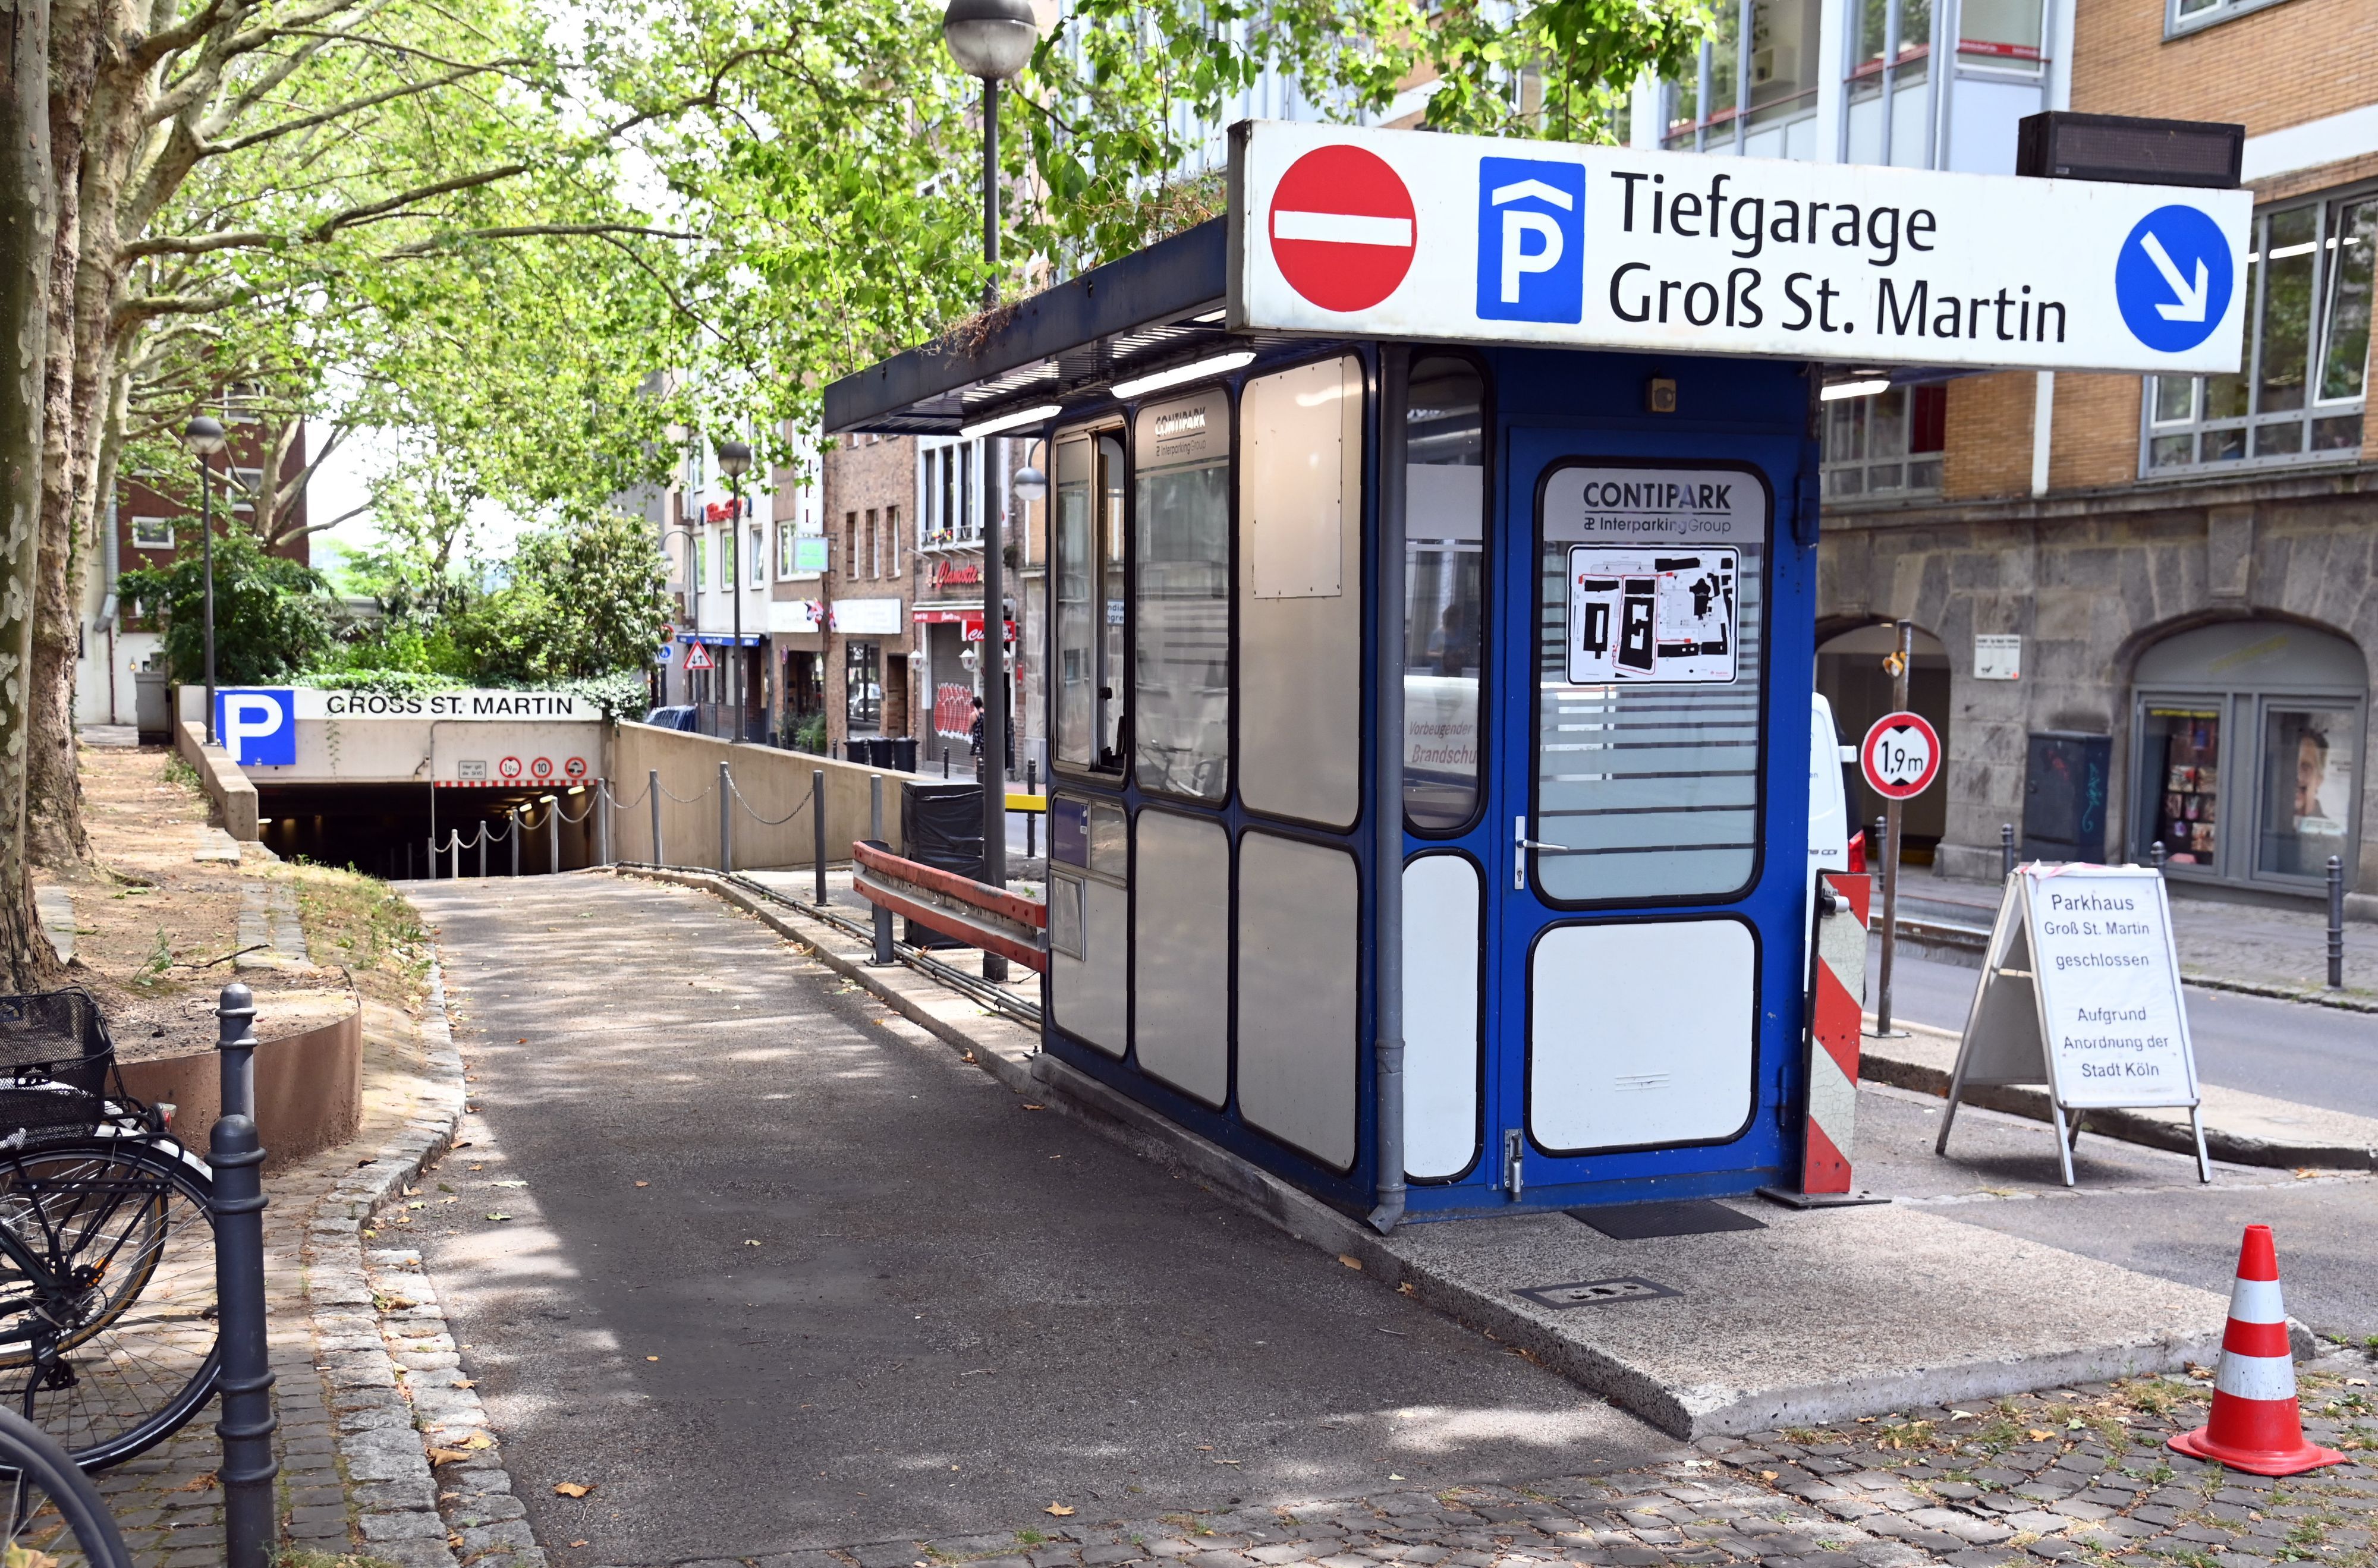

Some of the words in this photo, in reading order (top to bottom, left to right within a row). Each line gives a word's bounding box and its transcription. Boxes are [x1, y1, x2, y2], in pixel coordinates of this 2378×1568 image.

[1611, 170, 1936, 267] Tiefgarage
[1501, 209, 1564, 304] P
[1609, 262, 1763, 329] Groß
[1782, 272, 1854, 335] St.
[1876, 277, 2066, 343] Martin
[1155, 407, 1206, 437] CONTIPARK
[1583, 482, 1732, 509] CONTIPARK
[326, 695, 422, 714] GROSS
[430, 695, 463, 714] ST.
[473, 697, 573, 715] MARTIN
[224, 694, 284, 761] P
[1409, 720, 1473, 739] Vorbeugender
[537, 763, 548, 773] 10
[2051, 893, 2134, 911] Parkhaus
[2044, 921, 2078, 935] Groß
[2083, 921, 2102, 935] St.
[2106, 921, 2150, 935] Martin
[2056, 953, 2149, 970] geschlossen
[2078, 1006, 2146, 1025] Aufgrund
[2064, 1035, 2143, 1051] Anordnung
[2147, 1035, 2169, 1048] der
[2081, 1063, 2122, 1078] Stadt
[2125, 1062, 2160, 1076] Köln
